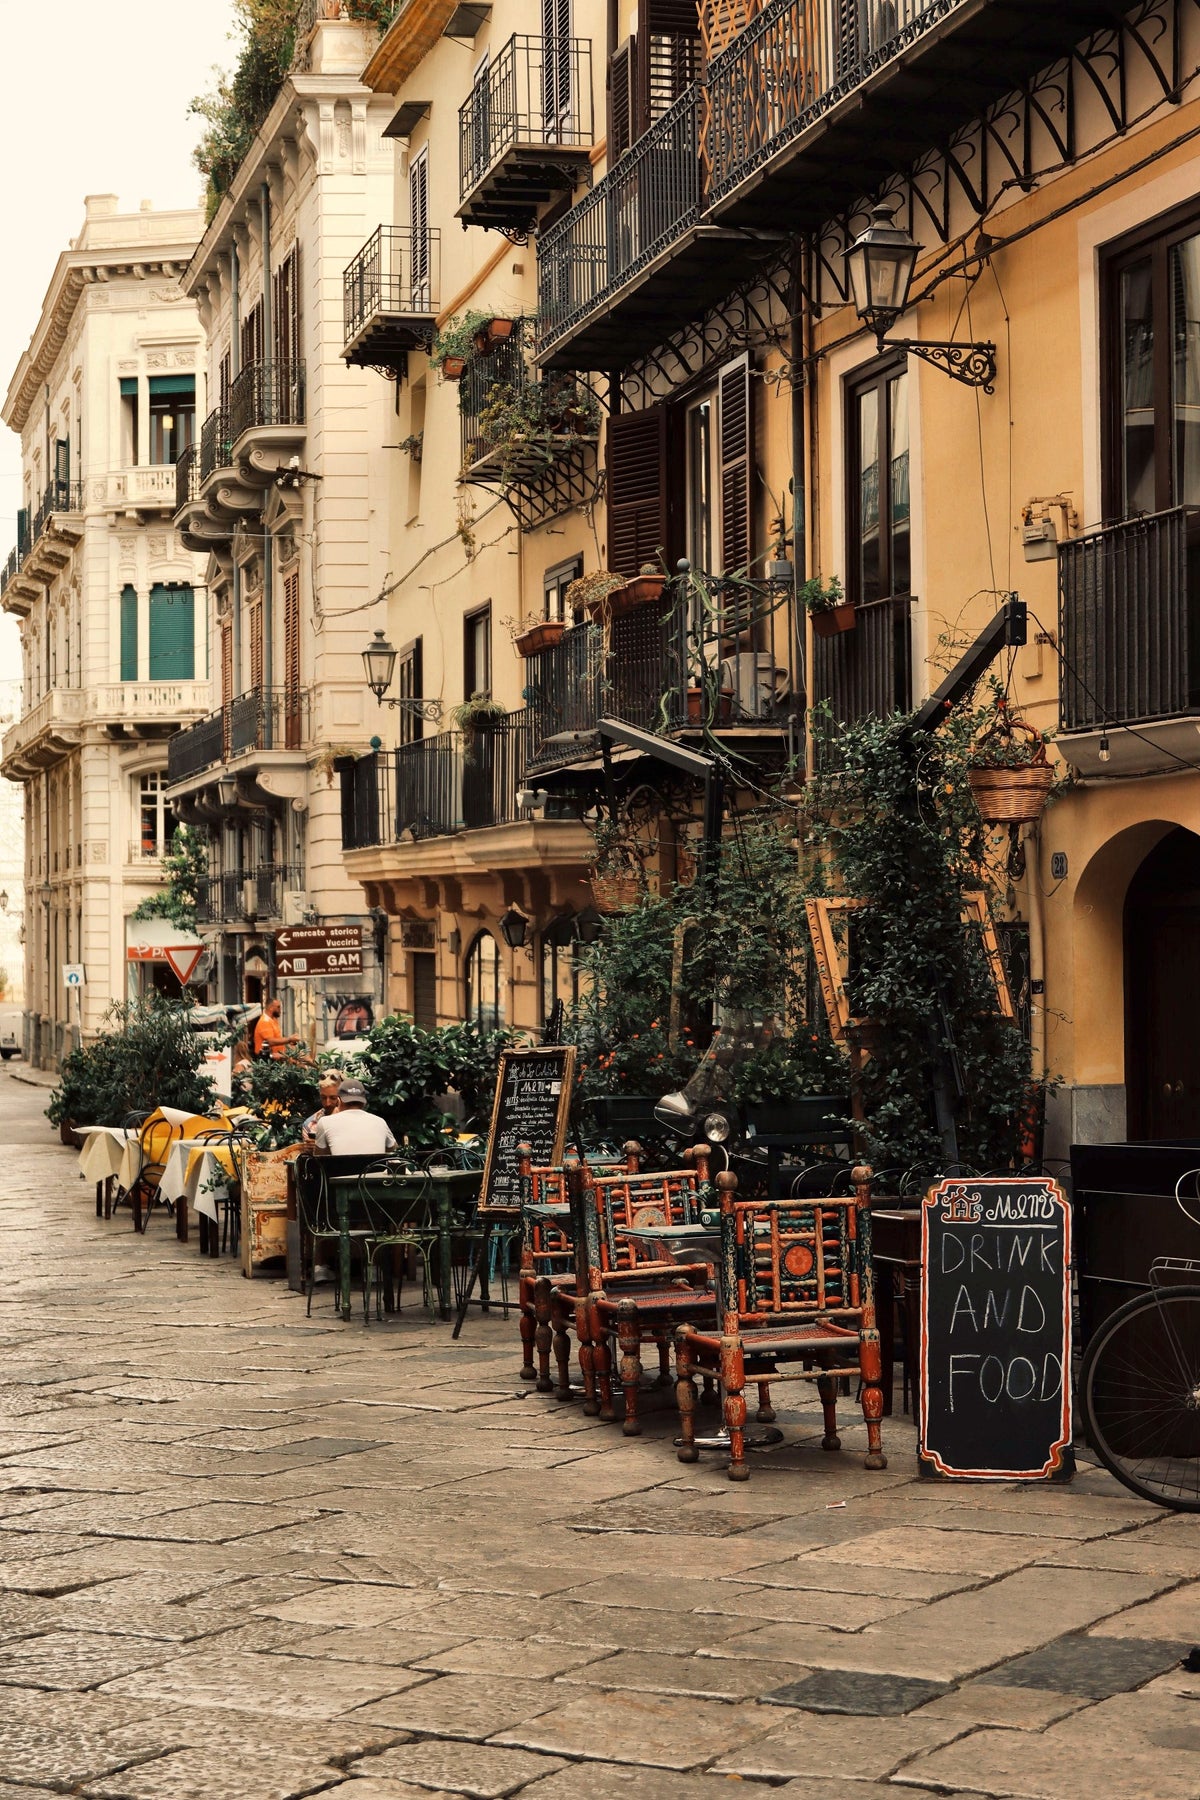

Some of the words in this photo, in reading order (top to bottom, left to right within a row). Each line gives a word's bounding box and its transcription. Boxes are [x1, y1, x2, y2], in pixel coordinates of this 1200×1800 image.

[1055, 856, 1064, 874] 28
[292, 929, 326, 937] mercato
[330, 928, 358, 936] storico
[326, 938, 358, 947] Vucciria
[327, 953, 360, 966] GAM
[940, 1231, 1058, 1274] DRINK
[949, 1284, 1046, 1334] AND
[948, 1352, 1063, 1413] FOOD
